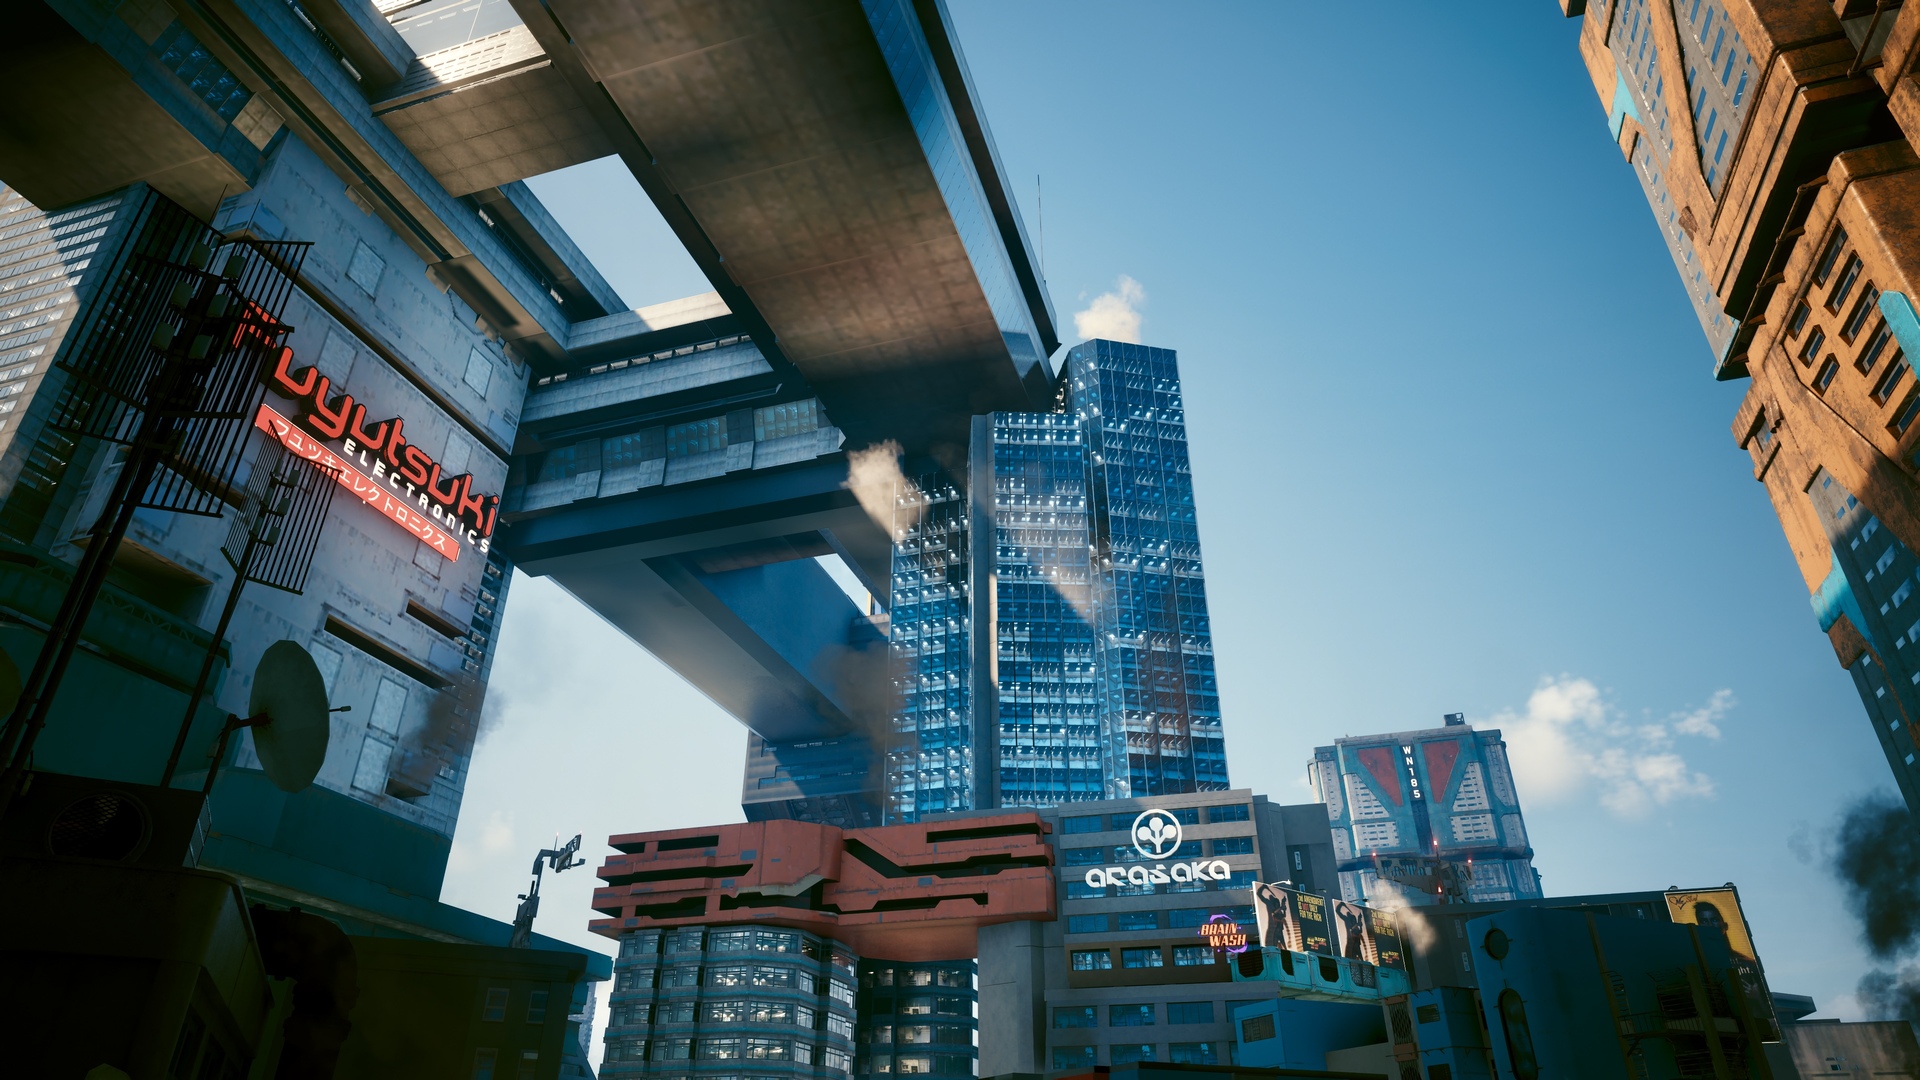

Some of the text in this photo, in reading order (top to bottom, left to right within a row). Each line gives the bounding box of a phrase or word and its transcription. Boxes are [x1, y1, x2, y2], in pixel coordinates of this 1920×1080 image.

[343, 438, 491, 554] ELECTRONICS
[1402, 745, 1421, 798] WN185
[1201, 923, 1238, 936] BRAIN
[1210, 934, 1247, 947] WASH
